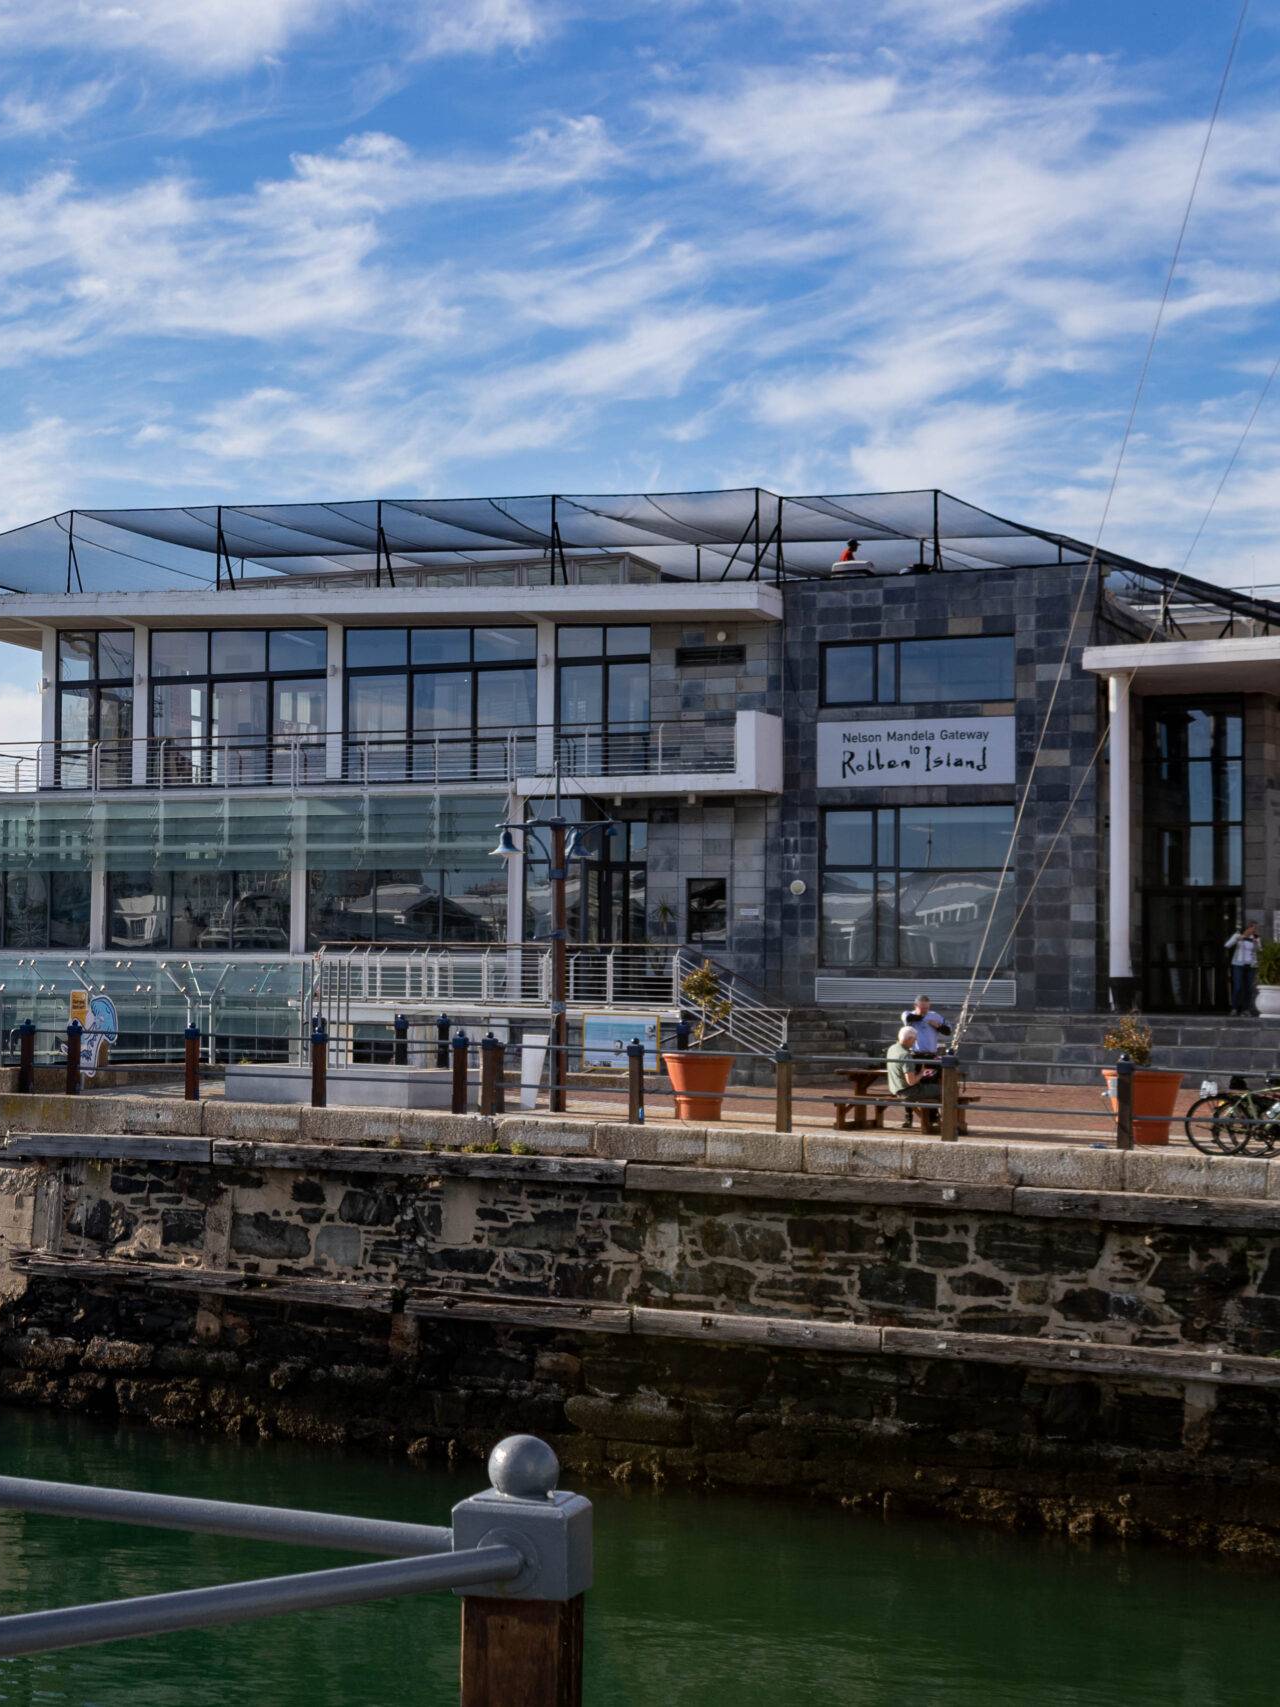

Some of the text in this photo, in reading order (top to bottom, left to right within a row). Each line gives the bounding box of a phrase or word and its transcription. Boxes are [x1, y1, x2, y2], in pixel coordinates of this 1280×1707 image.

[842, 729, 989, 743] Nelson Mandela Gateway
[909, 745, 920, 755] to
[842, 746, 987, 779] Robben Island
